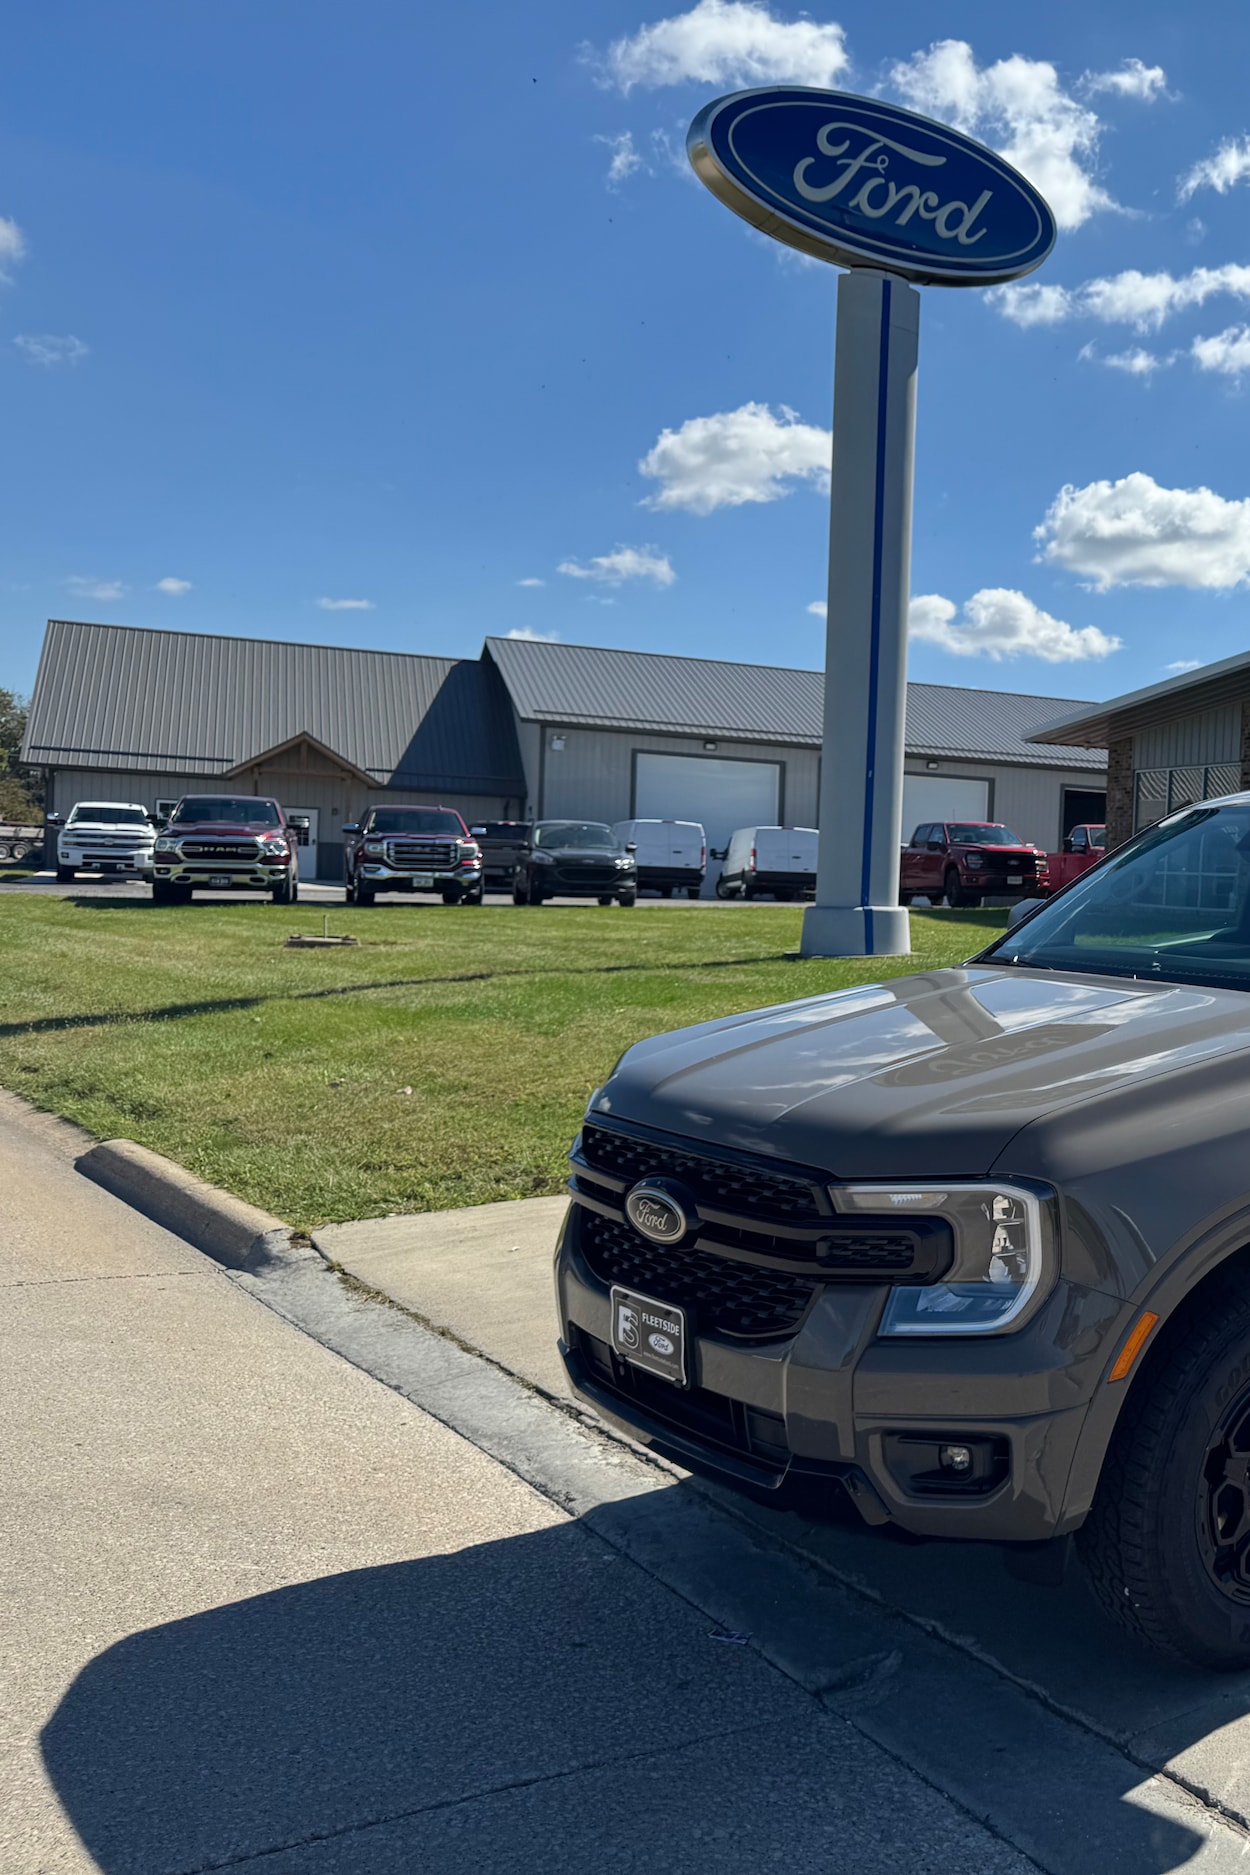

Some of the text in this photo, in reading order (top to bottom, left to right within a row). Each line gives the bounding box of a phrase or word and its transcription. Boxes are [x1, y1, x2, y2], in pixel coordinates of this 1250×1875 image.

[793, 121, 993, 245] Ford
[636, 1199, 668, 1230] Ford
[642, 1313, 680, 1336] FLEETSIDE
[653, 1335, 670, 1352] Ford
